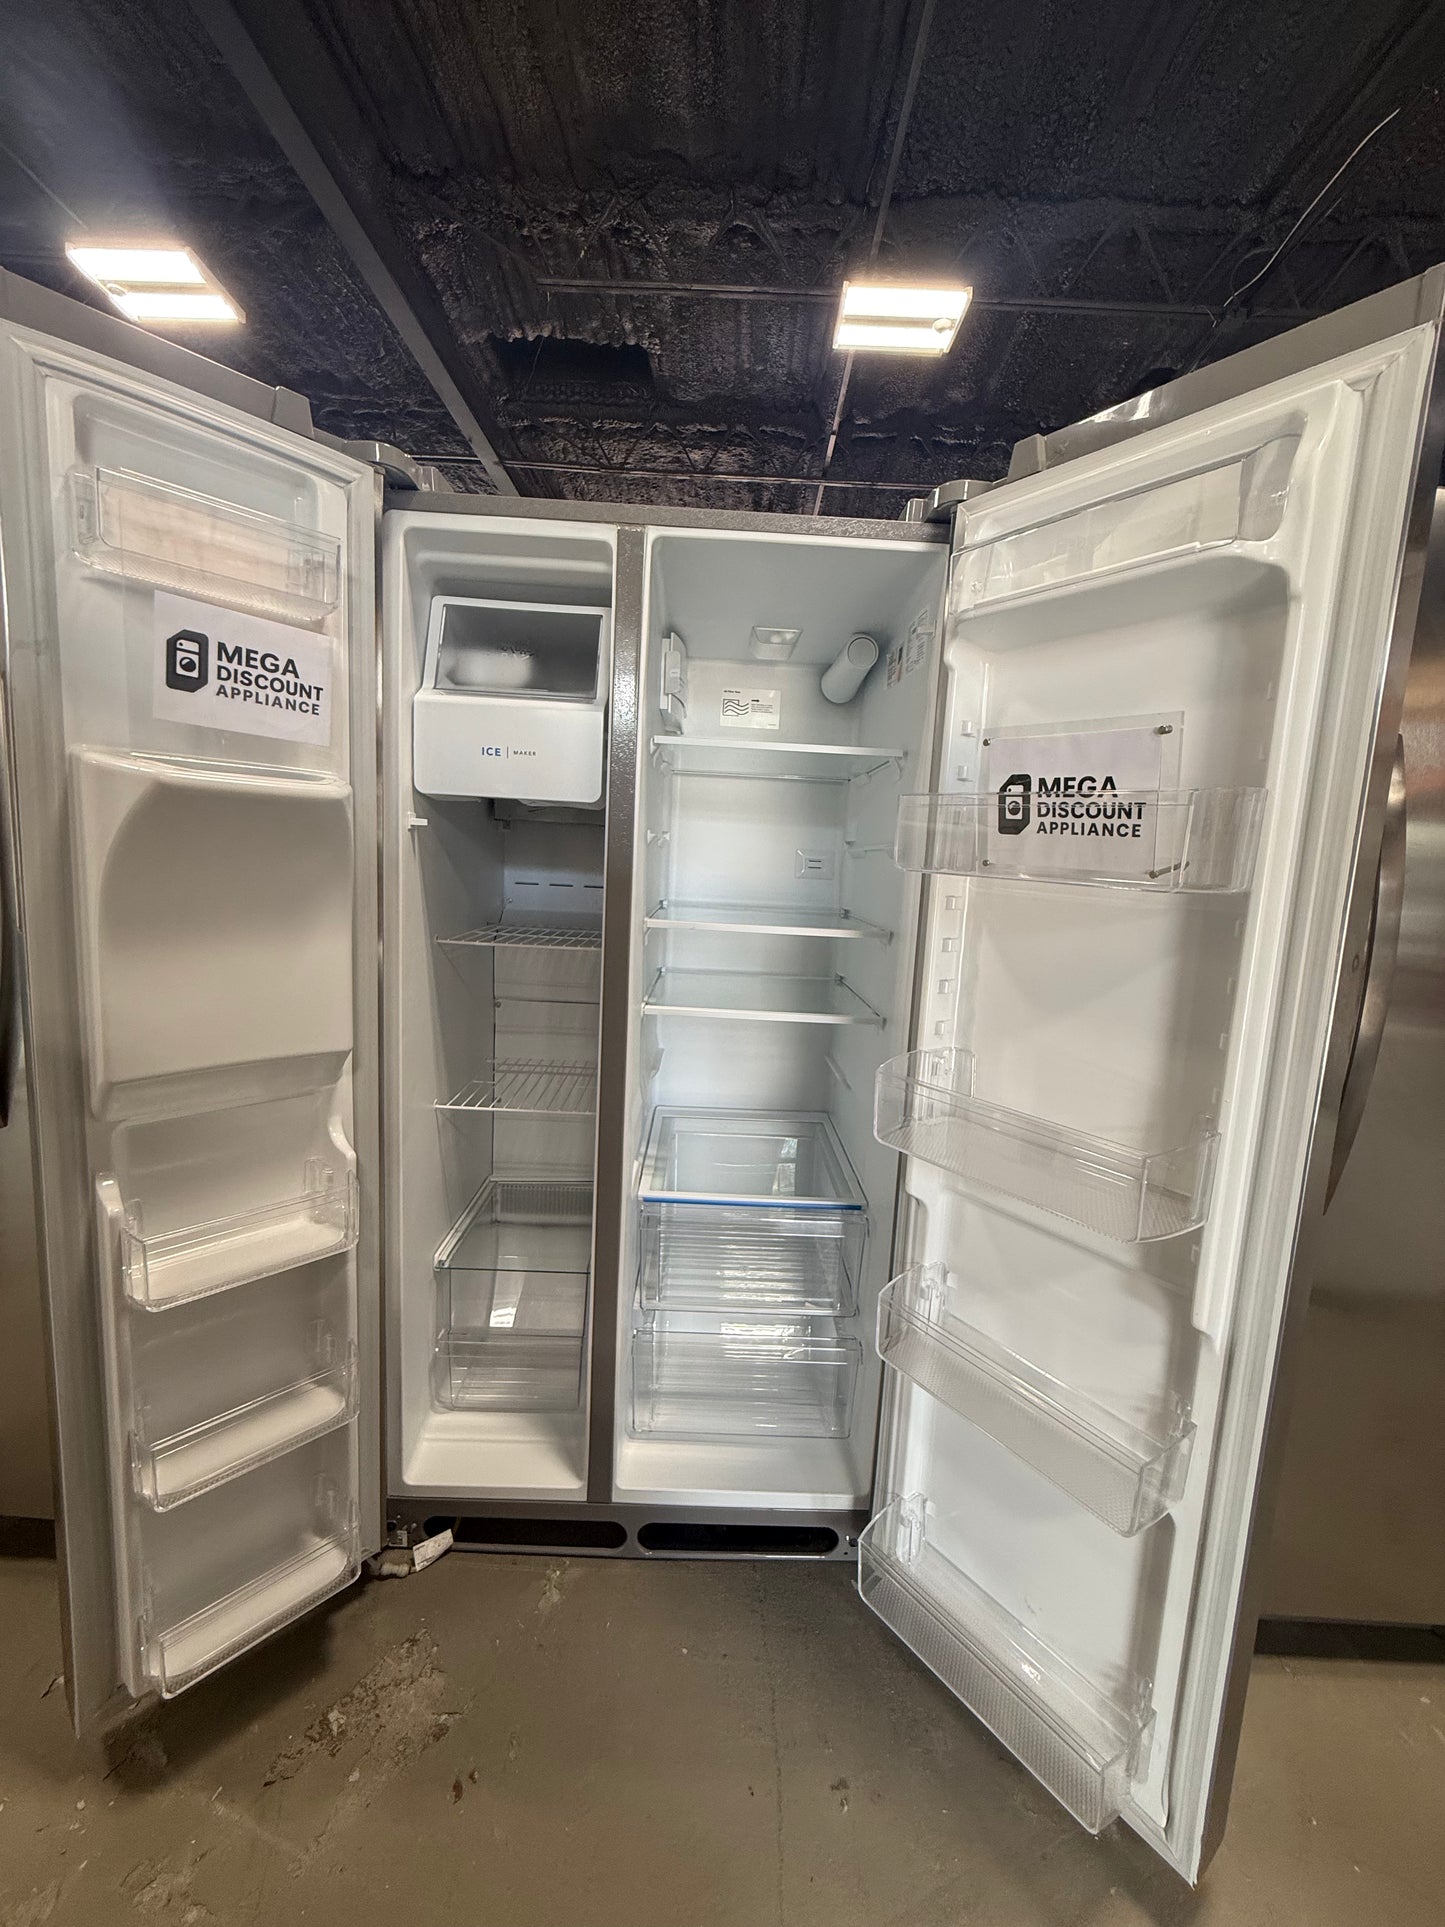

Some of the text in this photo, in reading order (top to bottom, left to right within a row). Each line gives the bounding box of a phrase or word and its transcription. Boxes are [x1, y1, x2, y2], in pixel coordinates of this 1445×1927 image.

[217, 641, 300, 679] MEGA
[216, 665, 324, 701] DISCOUNT
[216, 685, 320, 716] APPLIANCE
[481, 746, 502, 757] ICE
[1037, 775, 1119, 798] MEGA
[1037, 801, 1147, 820] DISCOUNT
[1036, 821, 1142, 838] APPLIANCE
